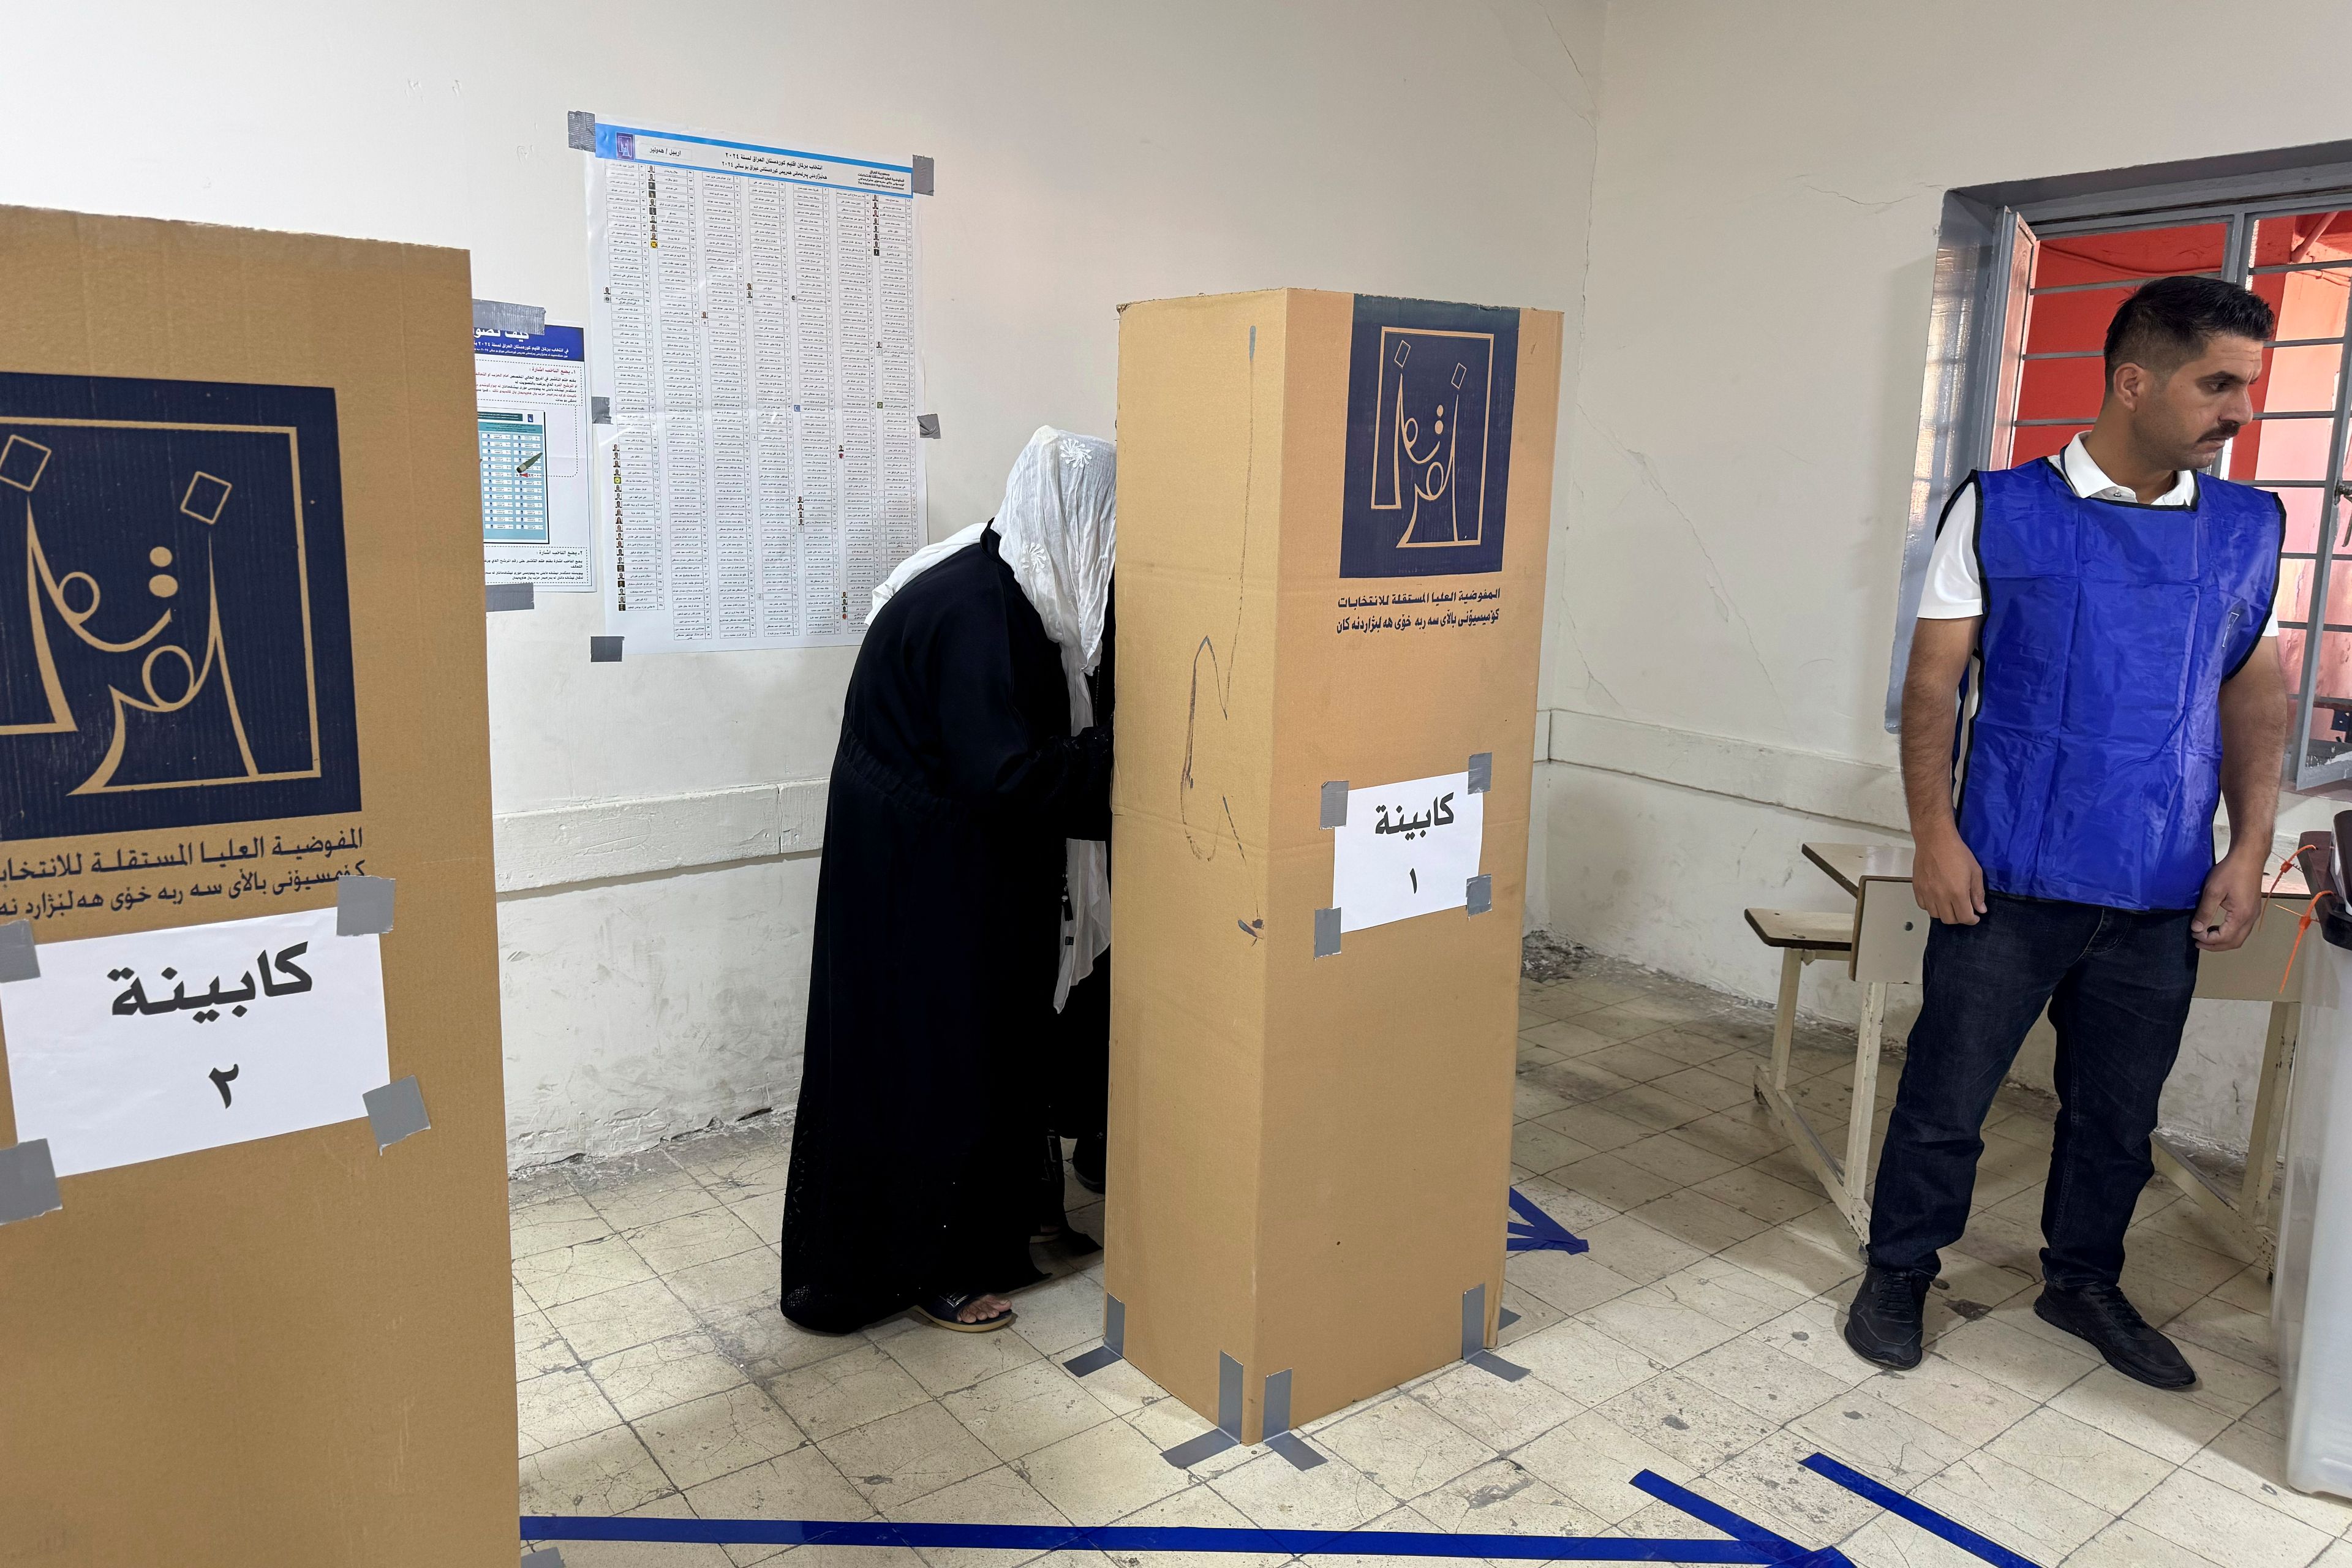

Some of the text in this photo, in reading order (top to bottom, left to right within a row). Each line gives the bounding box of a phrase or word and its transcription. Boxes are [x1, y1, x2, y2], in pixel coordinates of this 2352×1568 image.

[1338, 587, 1500, 610] المفوضية العليا المستقلة للانتخابات
[1375, 791, 1454, 841] كابينة
[0, 827, 363, 889] المفوضية العليا المستقلة للانتخاب
[1409, 867, 1417, 894] ١
[107, 940, 313, 1024] كابينة
[208, 1063, 239, 1109] ٢
